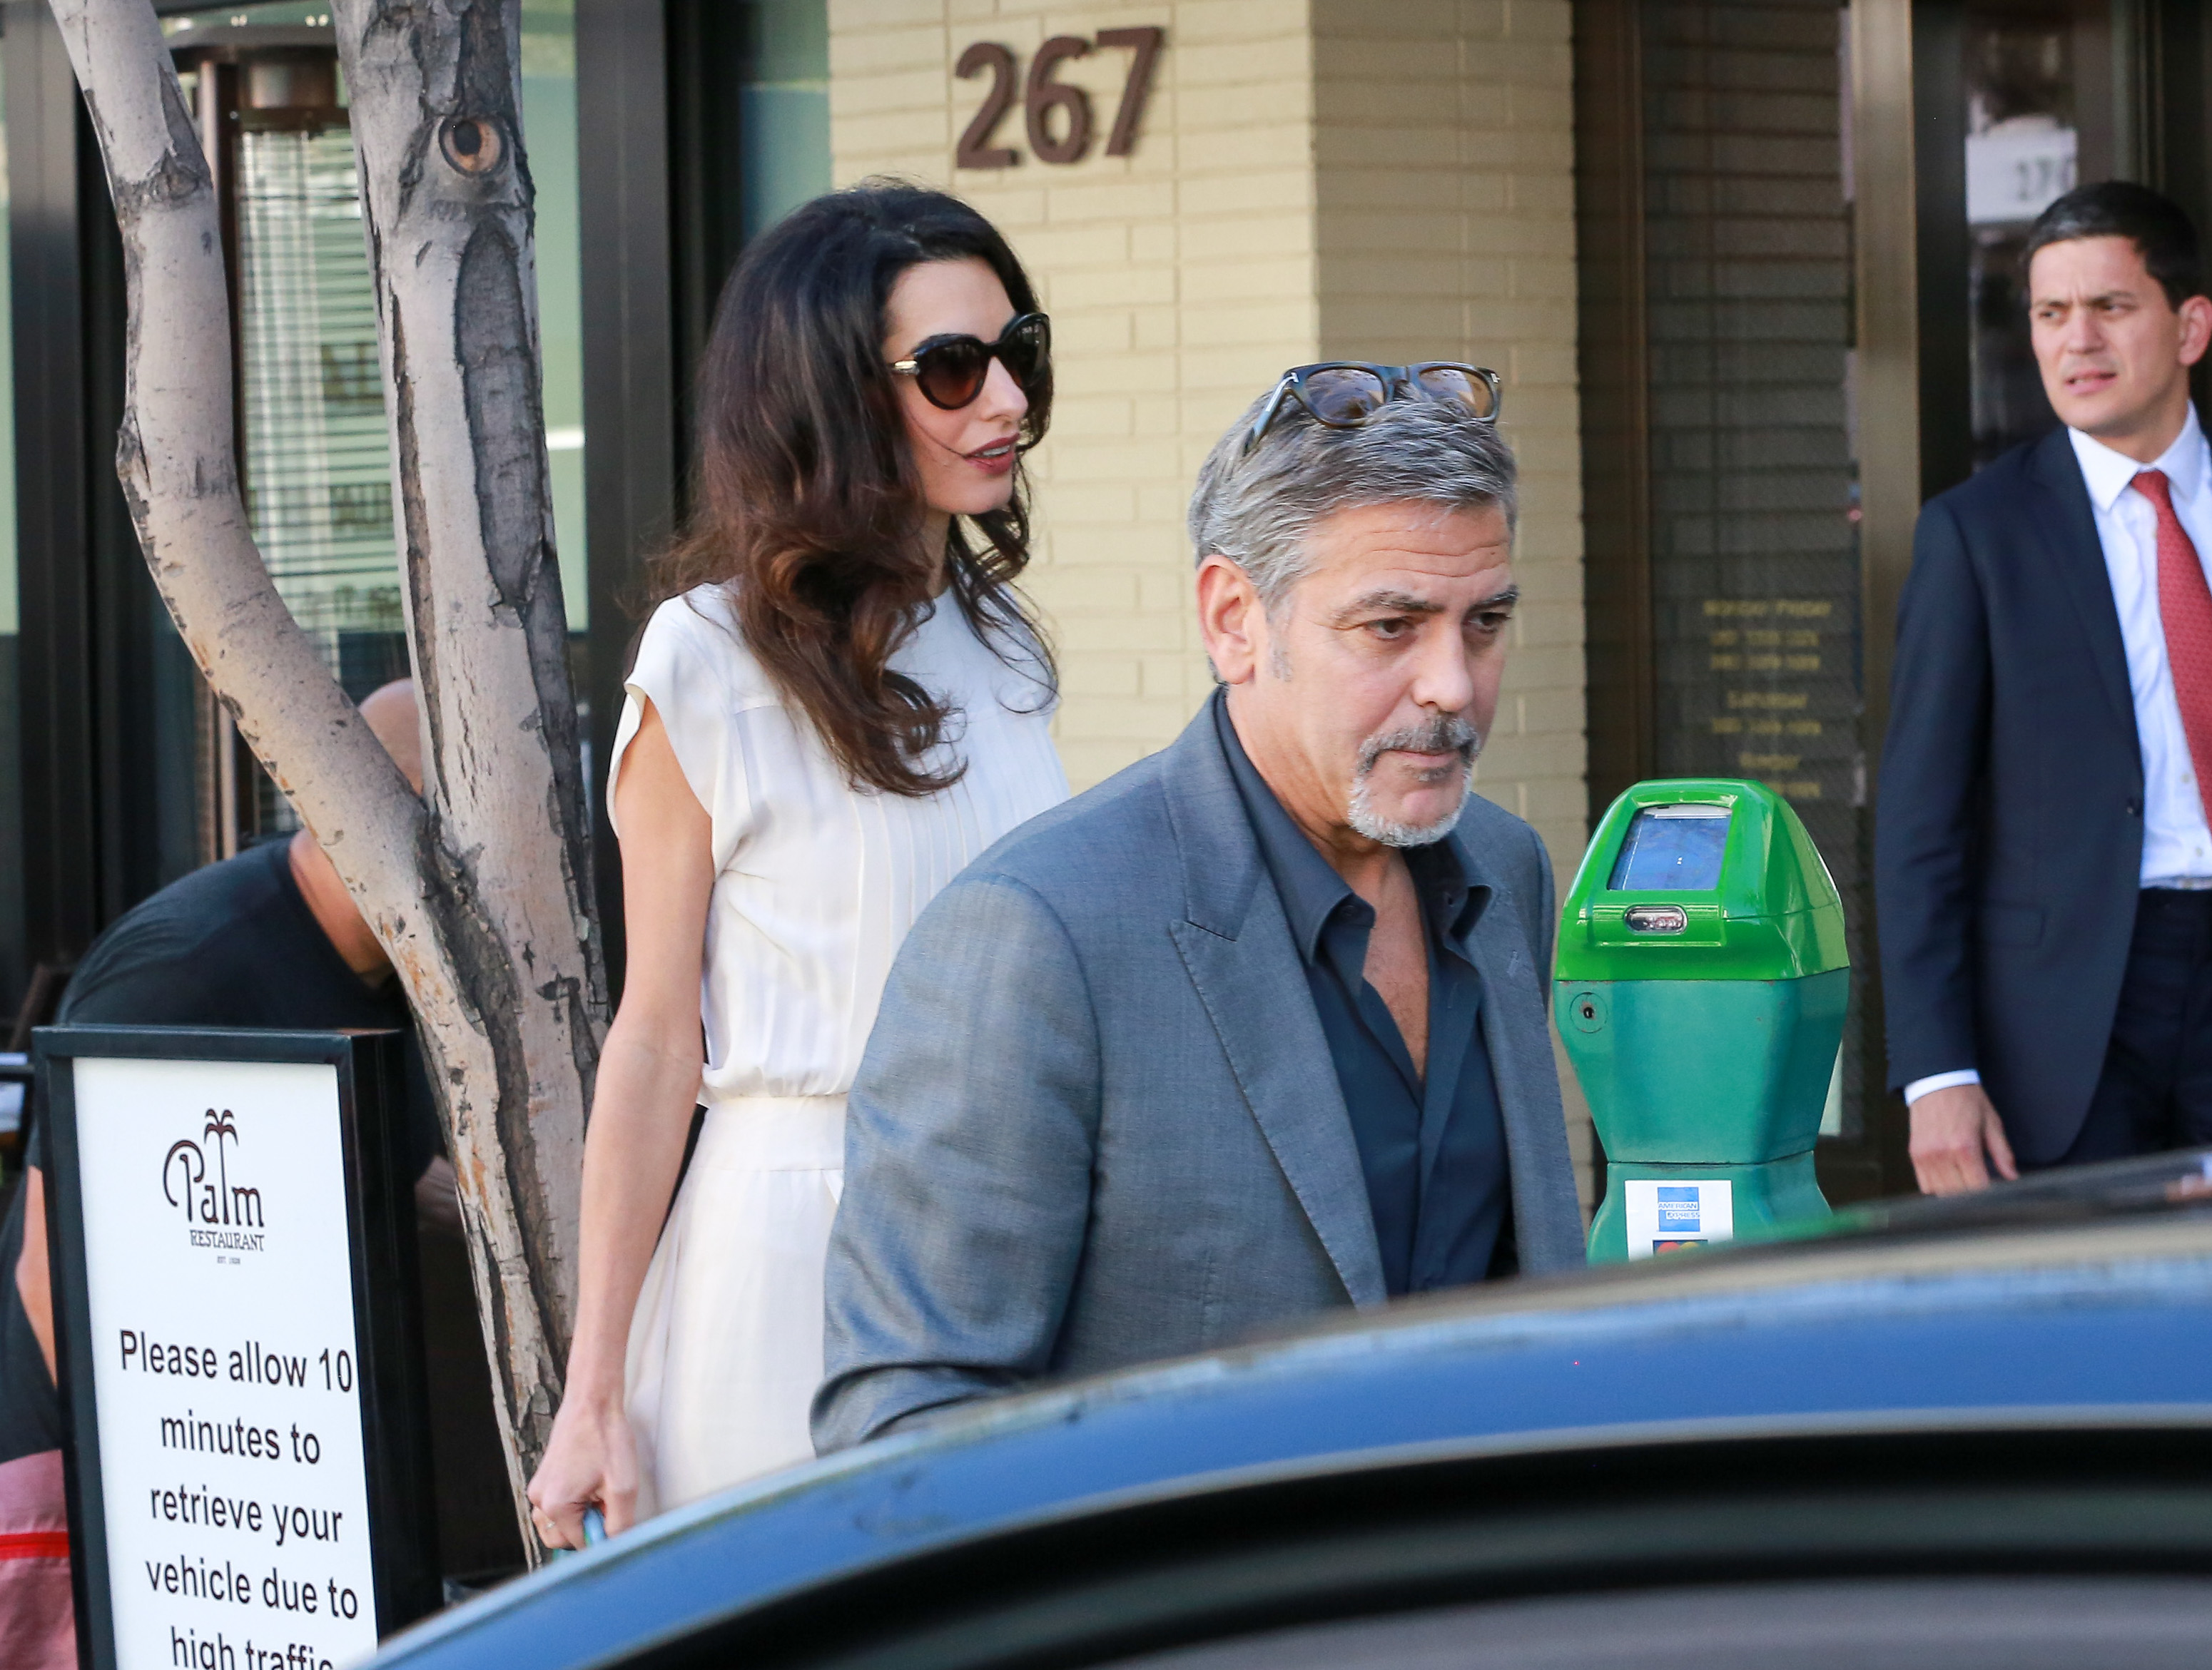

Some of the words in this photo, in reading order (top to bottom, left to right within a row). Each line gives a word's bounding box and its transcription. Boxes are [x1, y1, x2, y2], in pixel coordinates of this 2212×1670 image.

[955, 26, 1163, 170] 267
[163, 1109, 264, 1228] Palm
[189, 1228, 265, 1252] RESTAURANT
[120, 1329, 217, 1379] Please
[229, 1340, 307, 1388] allow
[319, 1348, 352, 1392] 10
[161, 1409, 280, 1460] minutes
[290, 1423, 320, 1465] to
[151, 1485, 262, 1532] retrieve
[273, 1504, 343, 1547] your
[145, 1554, 250, 1604] vehicle
[263, 1567, 318, 1614] due
[328, 1577, 358, 1619] to
[171, 1626, 235, 1670] high
